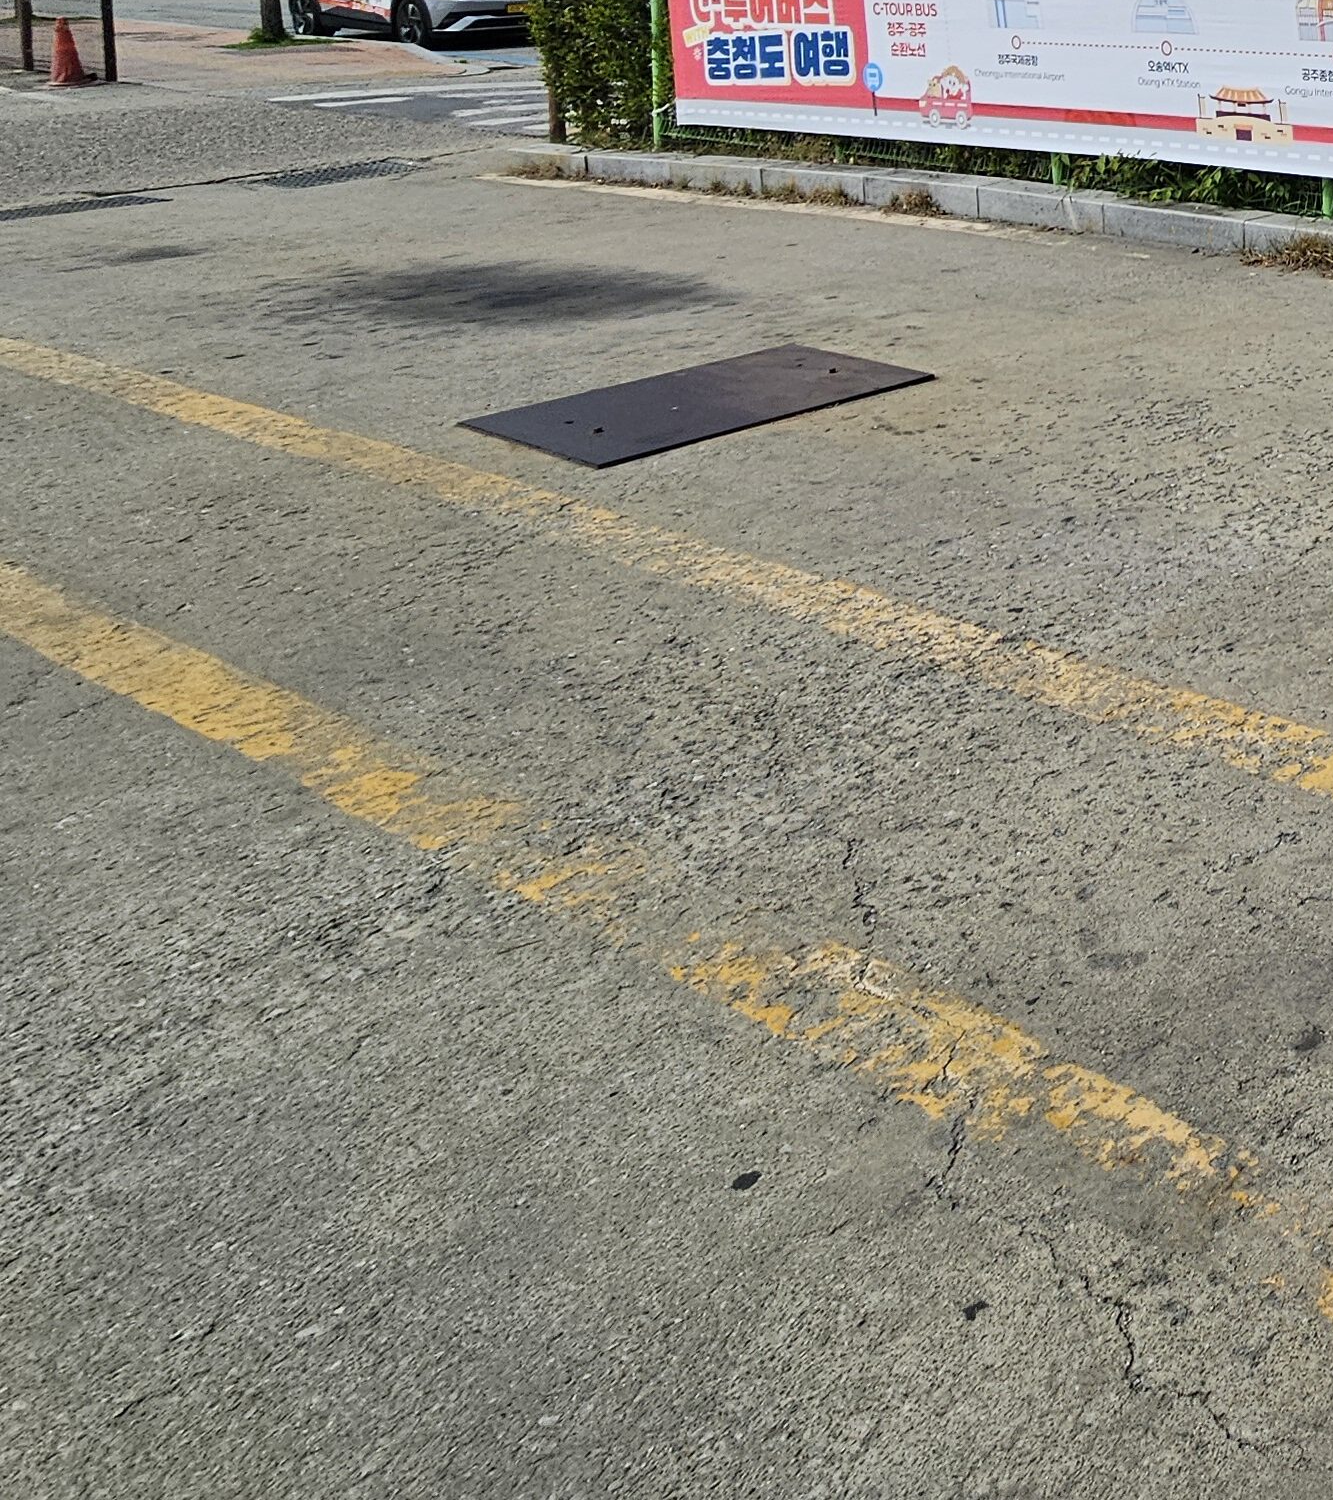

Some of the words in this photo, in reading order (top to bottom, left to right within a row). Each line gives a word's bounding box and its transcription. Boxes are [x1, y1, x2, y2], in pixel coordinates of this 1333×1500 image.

[872, 2, 913, 16] C-TOUR
[915, 3, 938, 17] BUS
[887, 22, 927, 37] 청주-공주
[706, 34, 786, 80] 충청도
[793, 30, 850, 77] 여행
[1147, 60, 1189, 74] 오송역KTX
[1043, 73, 1065, 82] Airport
[1285, 86, 1314, 98] Gongju
